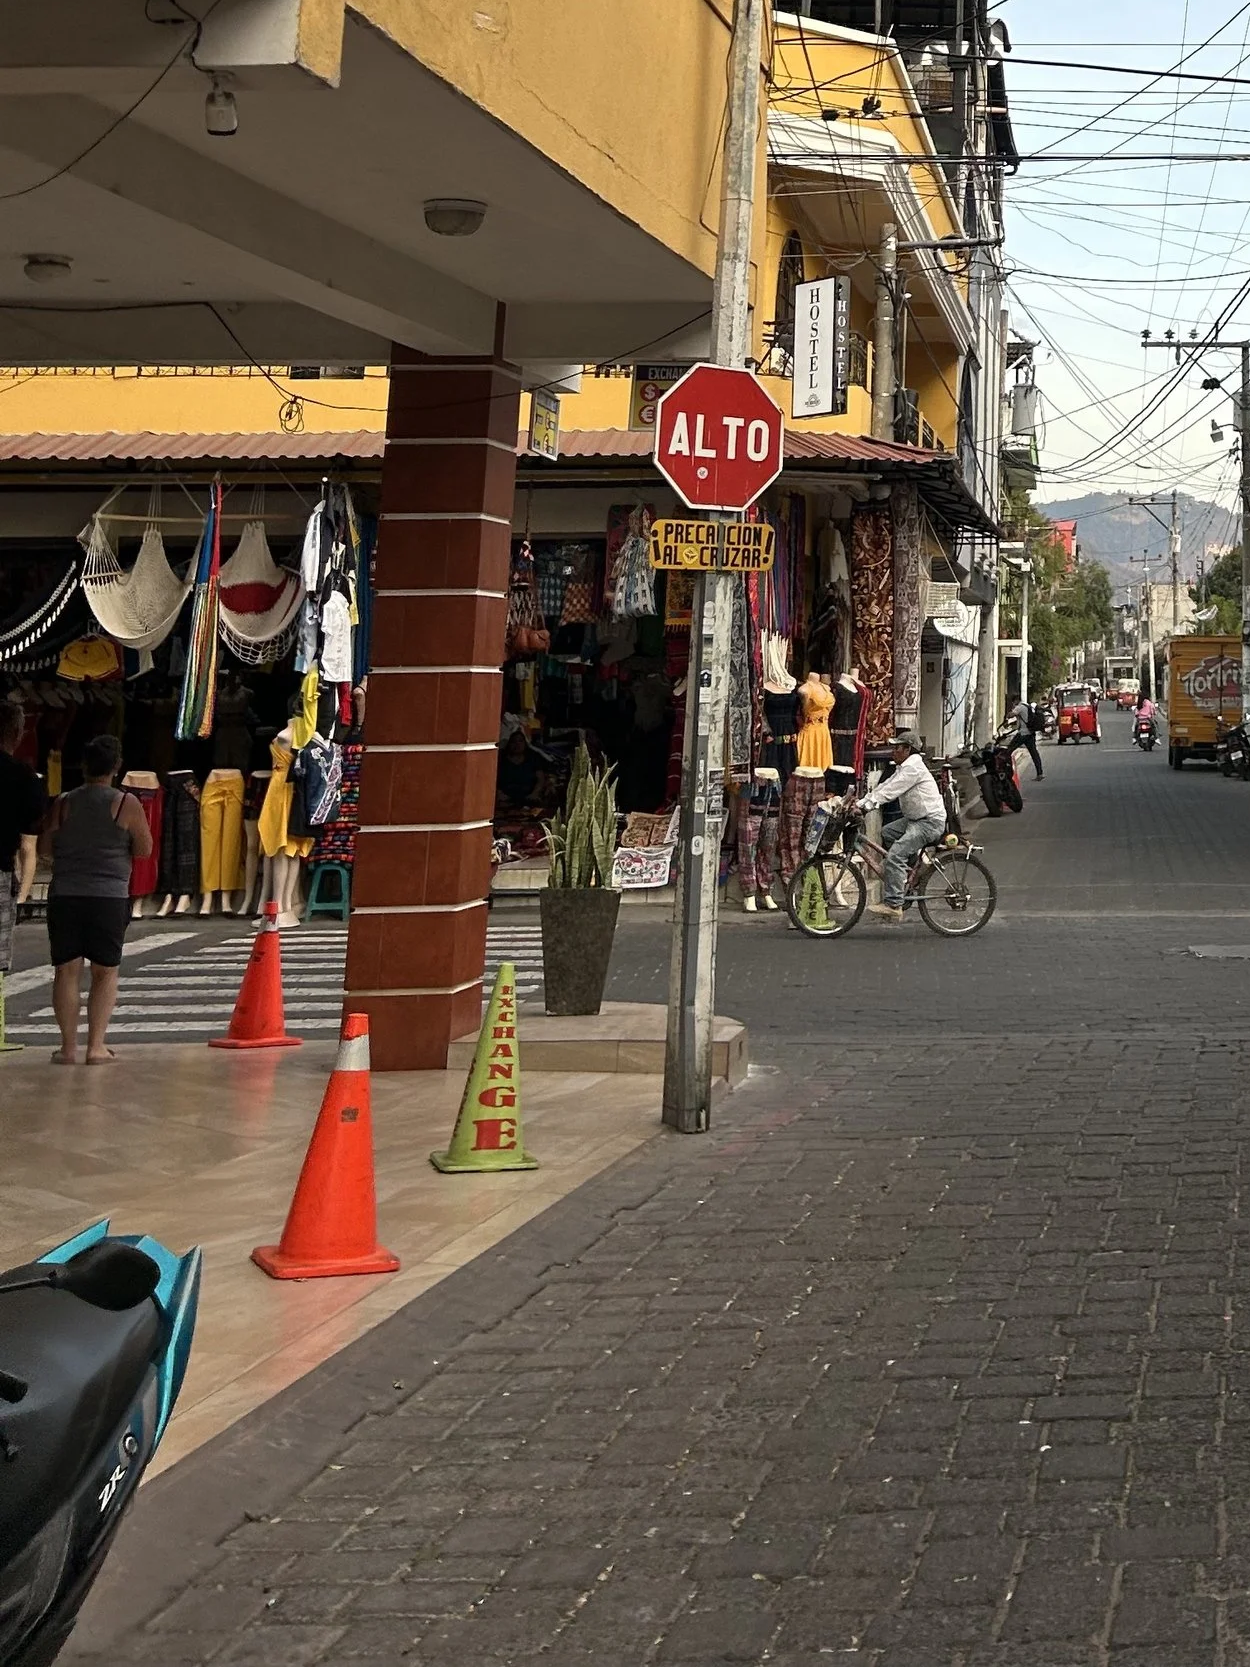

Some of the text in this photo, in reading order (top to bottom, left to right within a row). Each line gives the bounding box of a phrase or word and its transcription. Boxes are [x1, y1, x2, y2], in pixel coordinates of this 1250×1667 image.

[809, 287, 820, 389] HOSTEL
[836, 300, 847, 390] HOSTEL
[668, 411, 770, 462] ALTO
[663, 545, 682, 565] AL
[471, 985, 518, 1151] EXCHANGE
